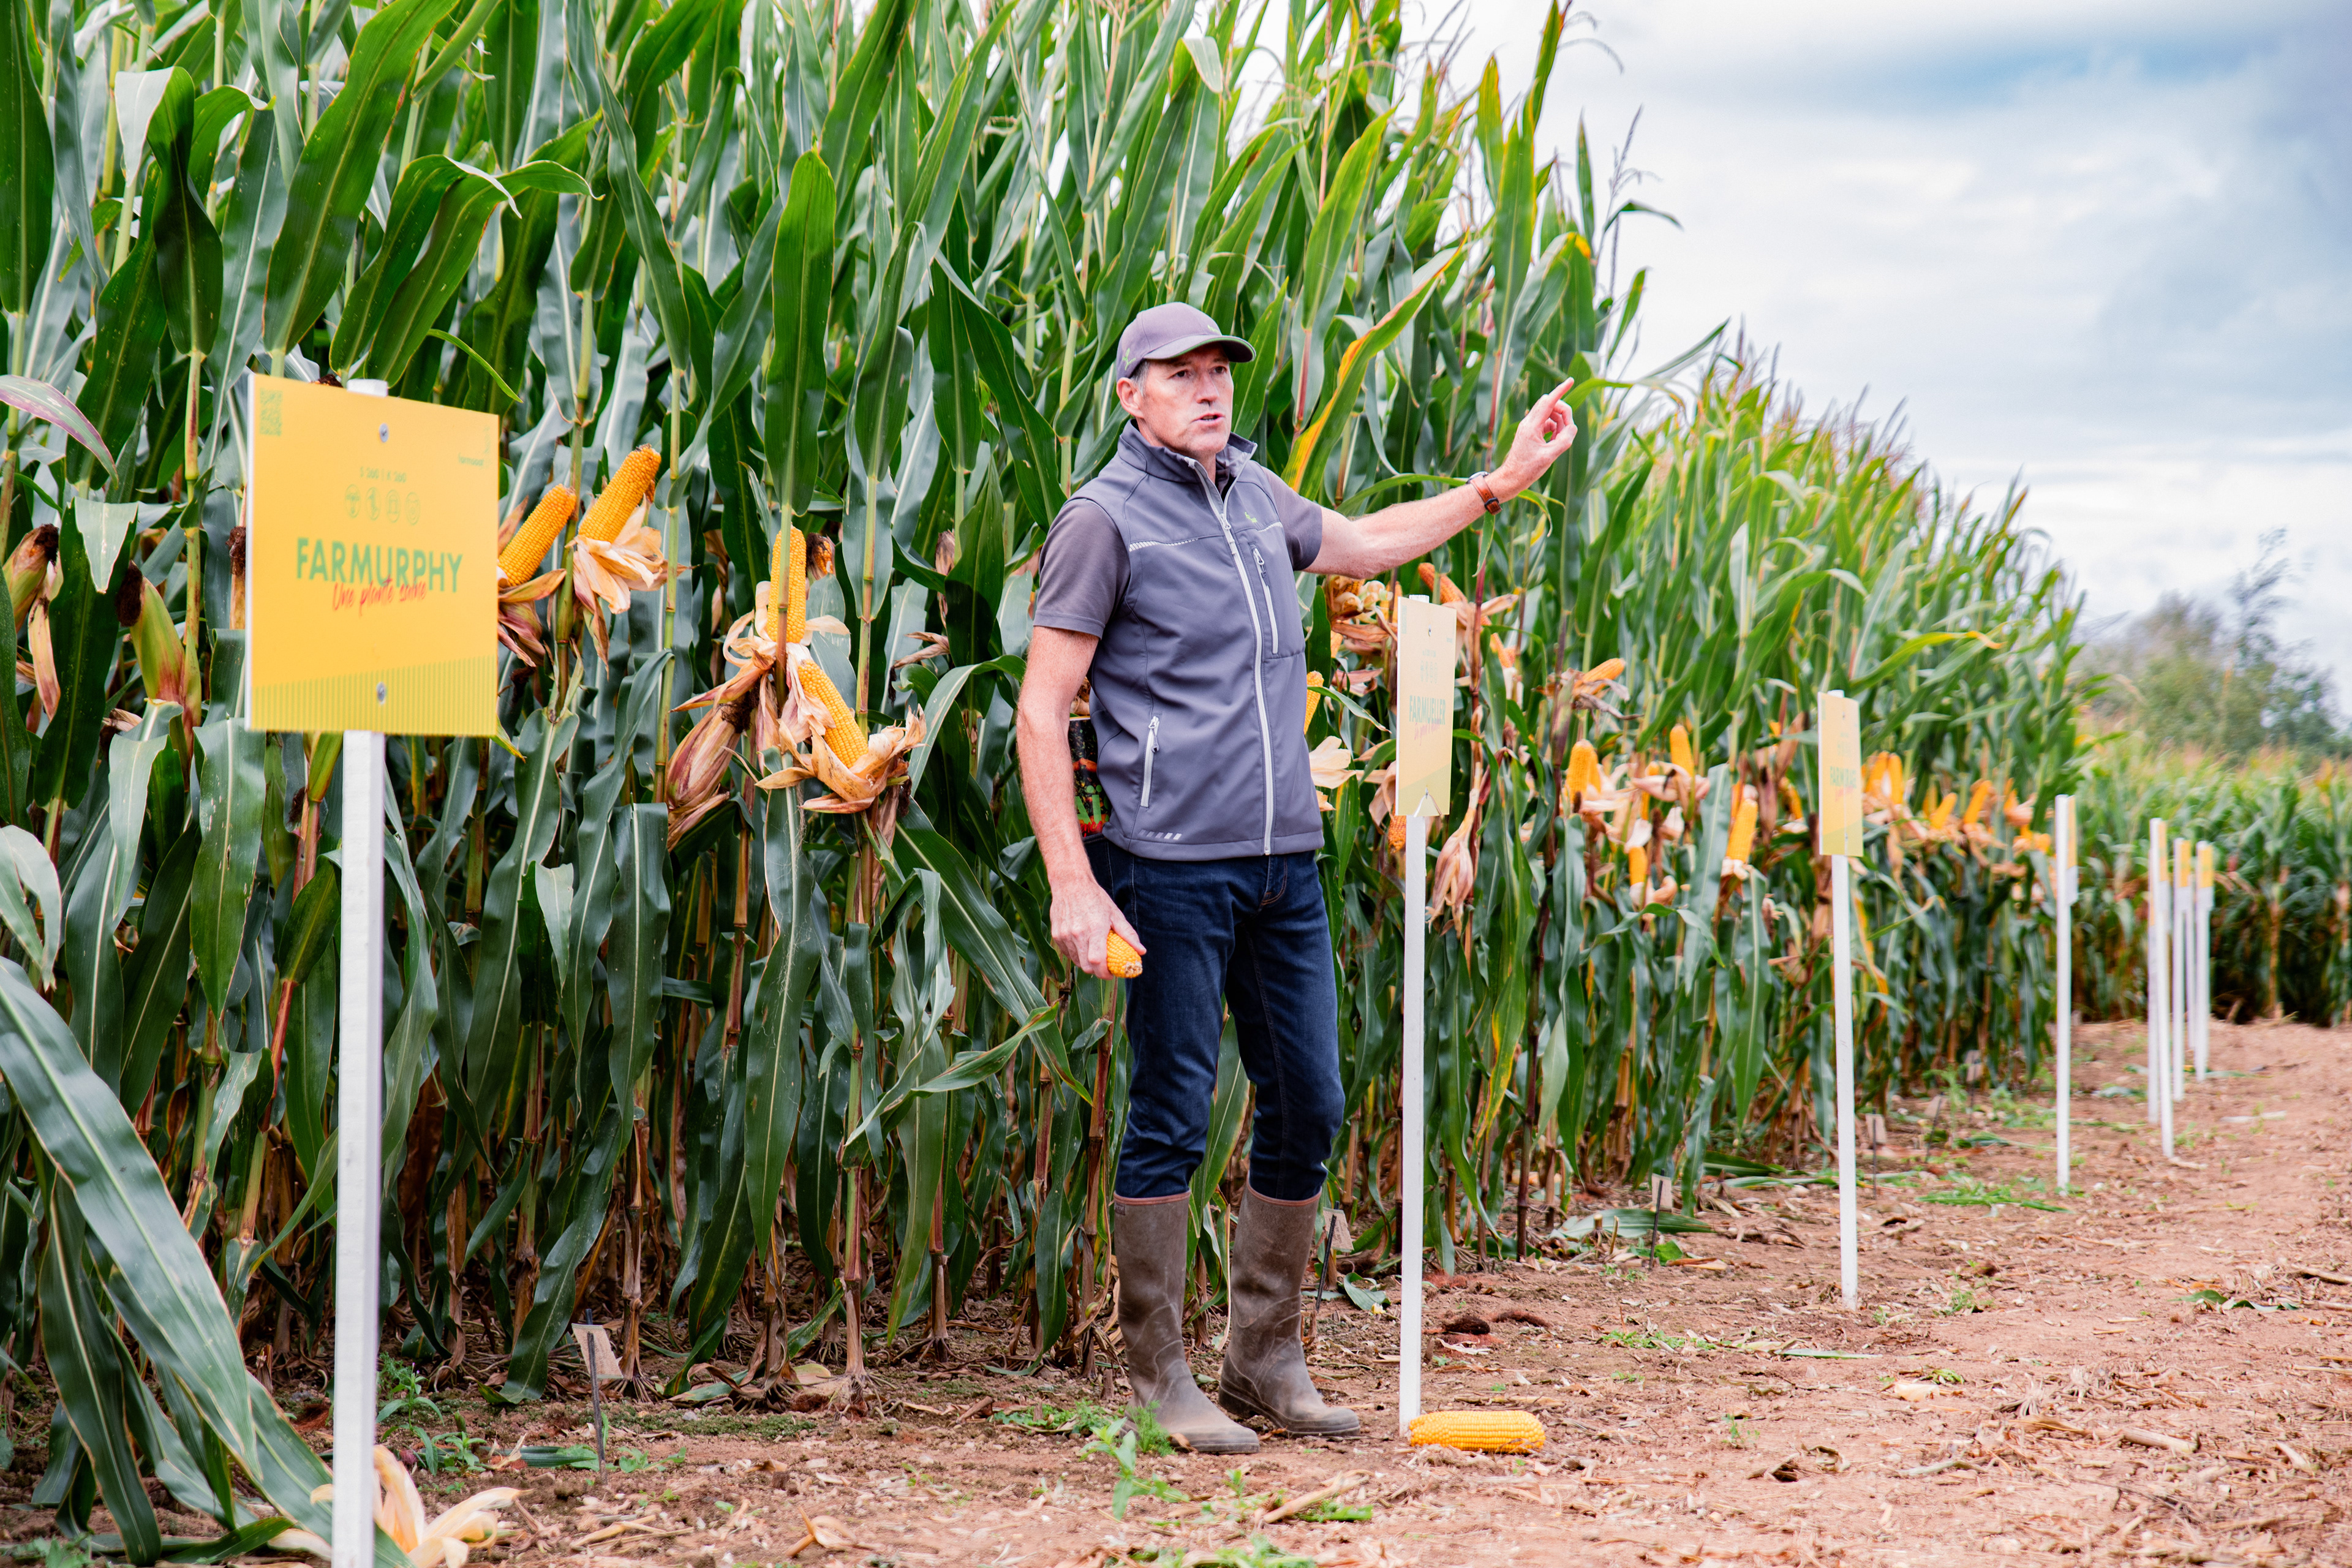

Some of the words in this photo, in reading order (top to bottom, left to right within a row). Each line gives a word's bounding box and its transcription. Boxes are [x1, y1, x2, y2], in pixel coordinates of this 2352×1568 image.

[296, 537, 463, 593] FARMURPHY
[332, 582, 355, 611] Une
[358, 573, 394, 618] plante
[399, 575, 428, 603] saine
[1409, 695, 1446, 725] FARMUELLER
